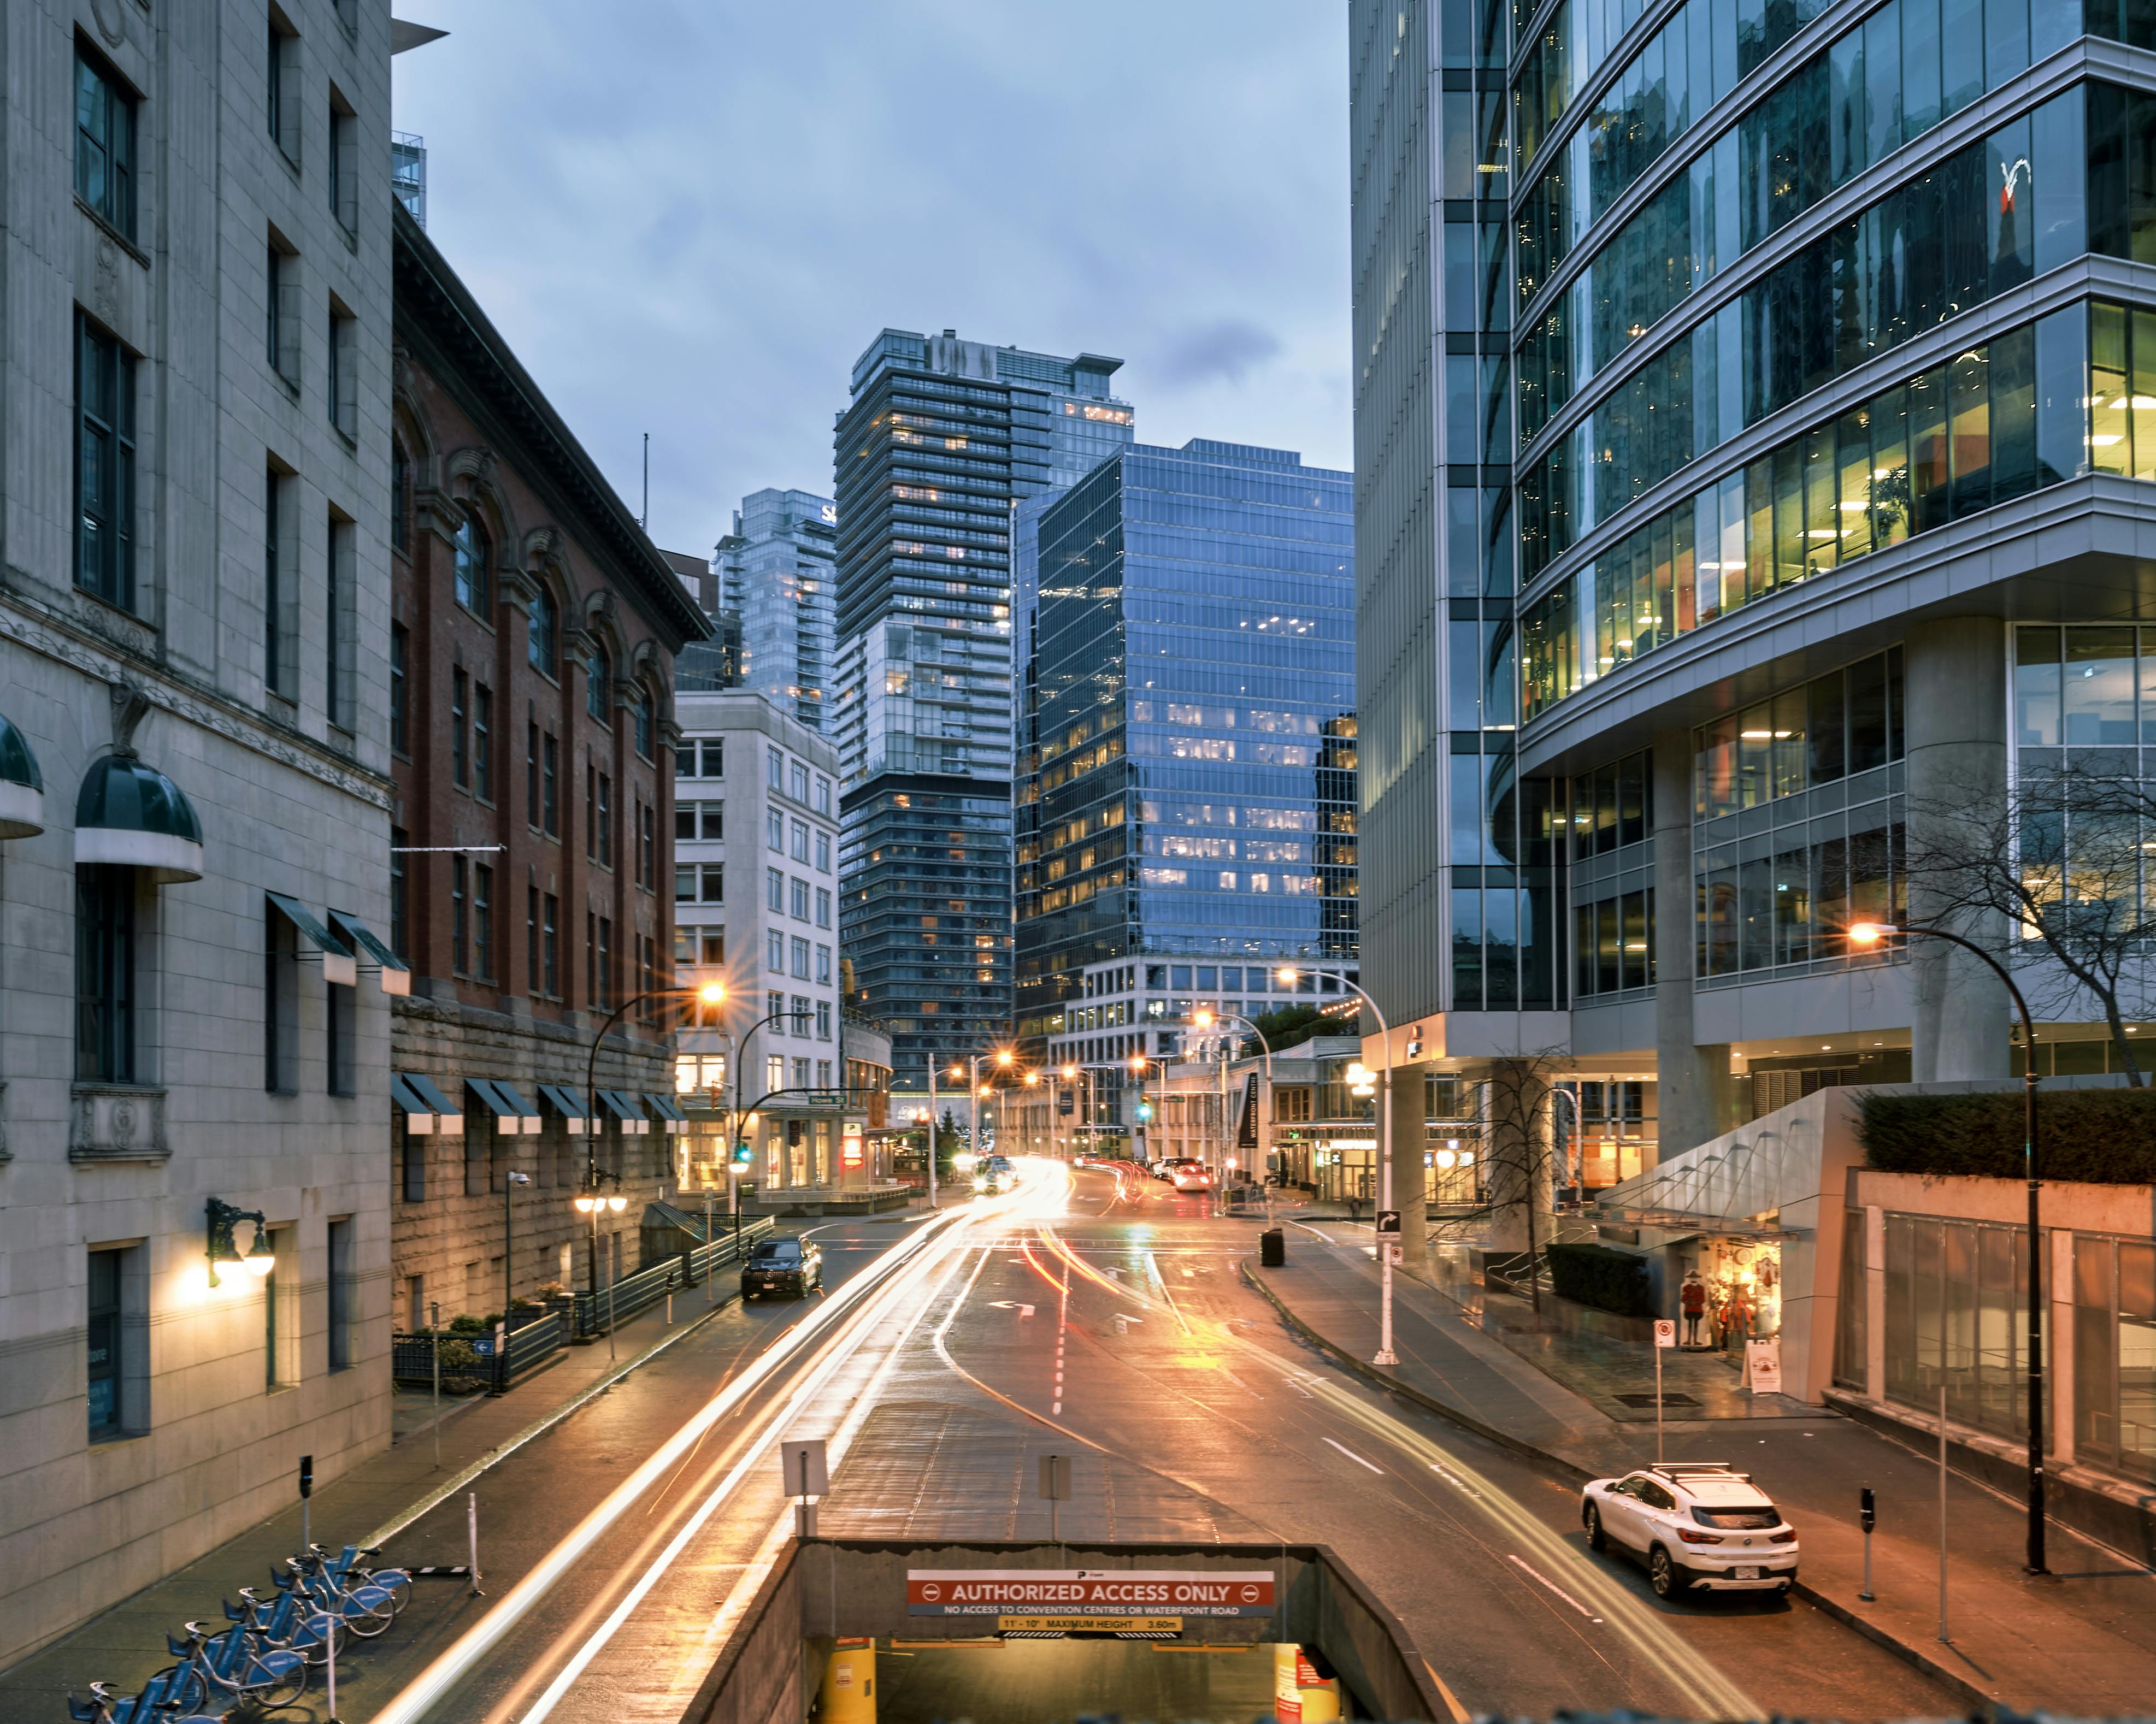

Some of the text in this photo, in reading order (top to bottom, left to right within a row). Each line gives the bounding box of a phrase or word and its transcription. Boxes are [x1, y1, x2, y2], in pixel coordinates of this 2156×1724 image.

[951, 1584, 1230, 1601] AUTHORIZED ACCESS ONLY
[944, 1605, 960, 1614] NO
[962, 1605, 998, 1614] ACCESS
[1000, 1605, 1014, 1614] TO
[1016, 1606, 1081, 1614] CONVENTION
[1083, 1606, 1126, 1614] CENTRES
[1144, 1607, 1209, 1615] WATERFRONT
[1046, 1620, 1093, 1628] MAXIMUM
[1097, 1620, 1133, 1628] HEIGHT
